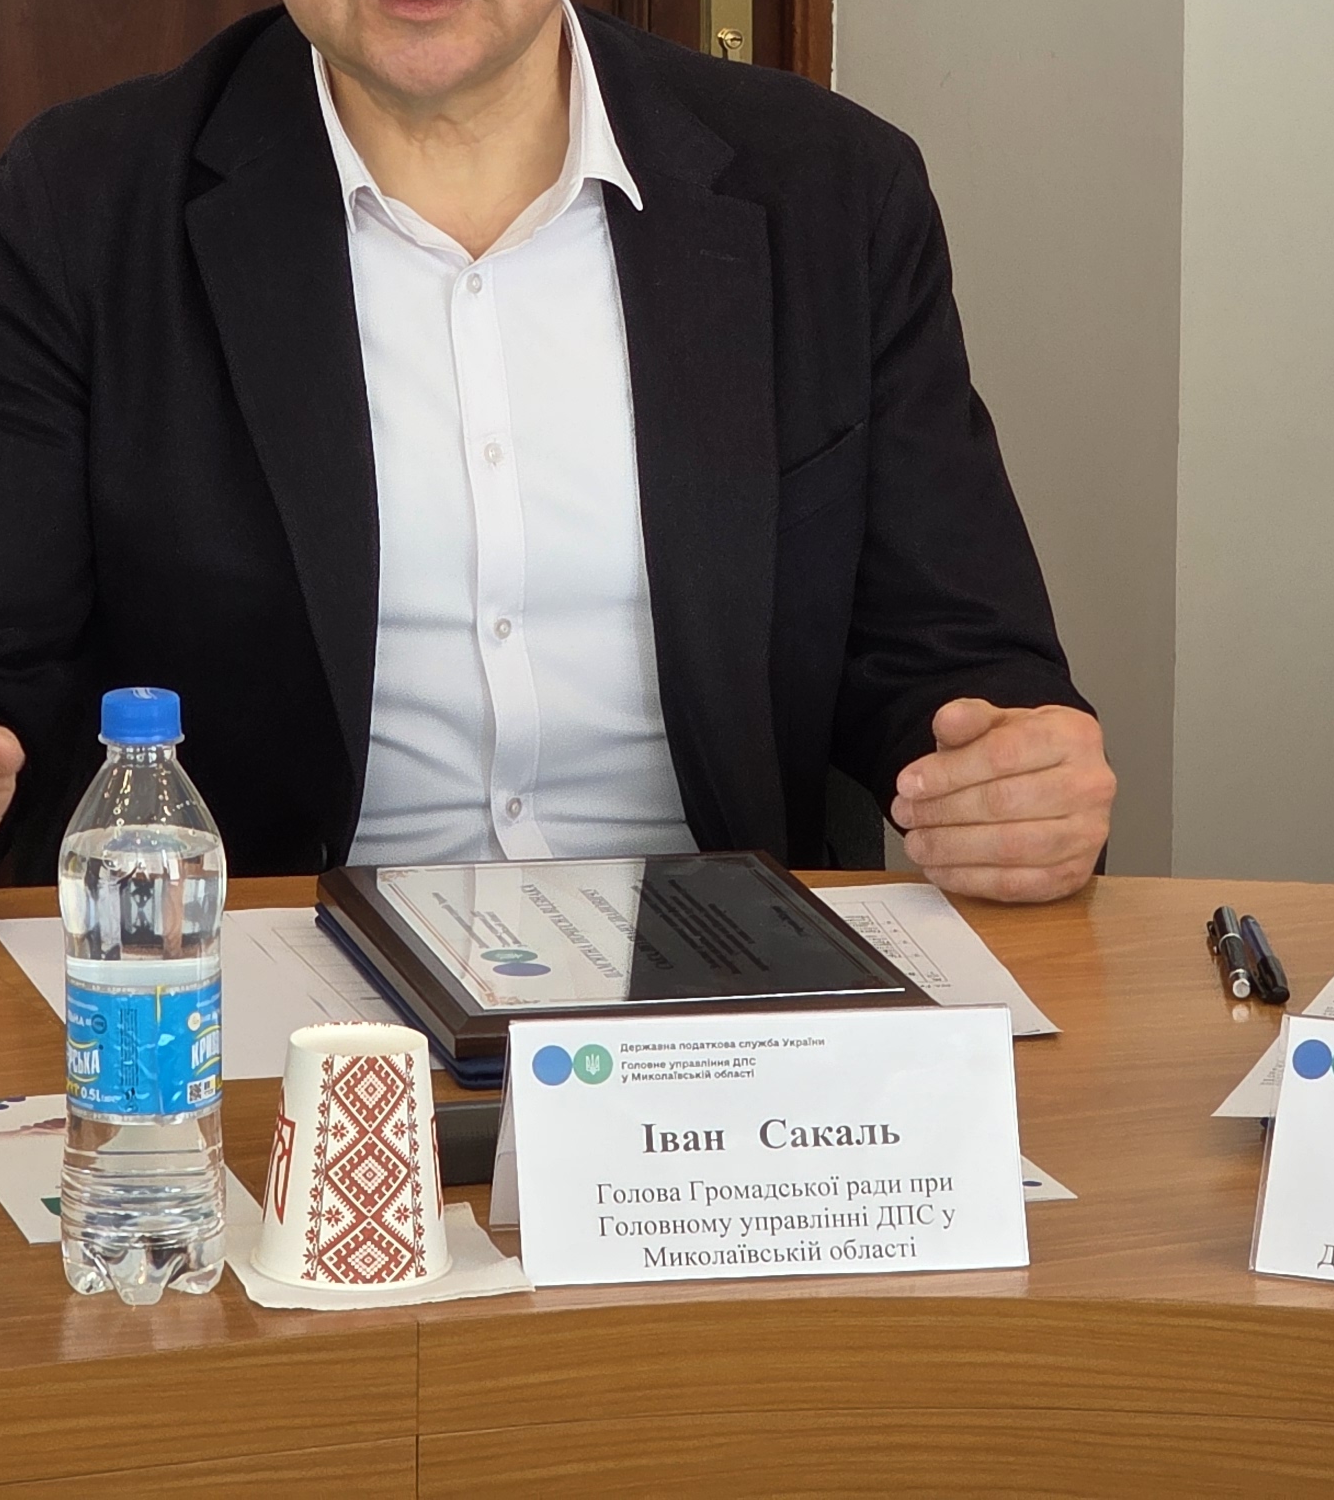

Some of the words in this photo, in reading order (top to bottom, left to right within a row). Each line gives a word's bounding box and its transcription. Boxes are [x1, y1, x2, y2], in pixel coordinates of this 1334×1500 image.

[620, 1043, 677, 1054] Державна
[678, 1041, 737, 1051] податкова
[738, 1037, 780, 1050] служба
[781, 1037, 825, 1049] України
[621, 1061, 667, 1070] Головне
[668, 1058, 730, 1071] управління
[732, 1057, 757, 1068] ДПС
[631, 1069, 712, 1082] Миколаївській
[713, 1068, 755, 1079] області
[640, 1123, 726, 1154] Іван
[759, 1118, 901, 1150] Сакаль
[596, 1183, 682, 1205] Голова
[689, 1175, 840, 1207] Громадської
[846, 1179, 902, 1202] ради
[909, 1176, 953, 1199] при
[598, 1215, 733, 1239] Головному
[739, 1205, 869, 1238] управлінні
[876, 1203, 935, 1231] ДПС
[941, 1208, 956, 1230] у
[642, 1239, 822, 1268] Миколаївській
[829, 1236, 917, 1261] області
